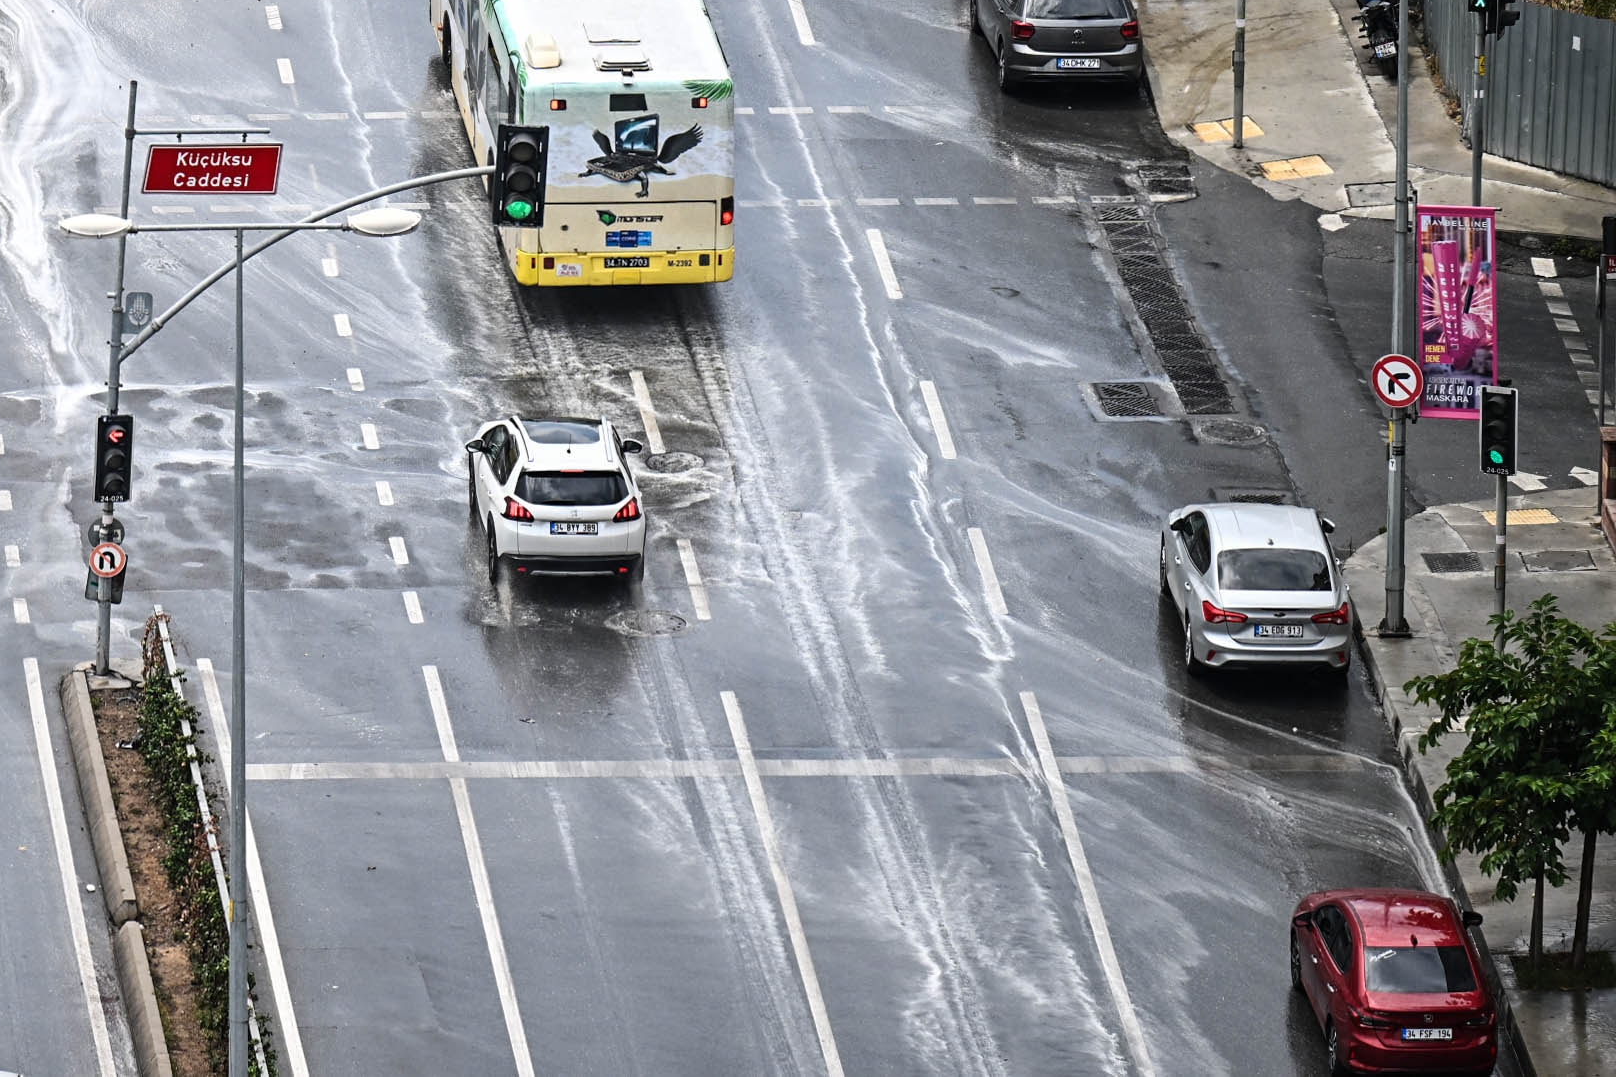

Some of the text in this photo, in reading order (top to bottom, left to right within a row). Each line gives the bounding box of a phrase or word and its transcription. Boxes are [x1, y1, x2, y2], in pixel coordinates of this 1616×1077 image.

[1062, 59, 1069, 67] 34
[176, 151, 252, 168] Küçüksu
[173, 172, 249, 187] Caddesi
[1425, 345, 1445, 353] HEMEN
[1425, 355, 1440, 363] DENE
[1426, 384, 1481, 396] FIREWOR
[1426, 395, 1469, 403] MASKARA
[1486, 467, 1508, 475] 24-025
[556, 523, 563, 532] 34
[1260, 626, 1269, 635] 34
[1287, 626, 1302, 635] 913
[1408, 1030, 1451, 1038] 34 FSF 194
